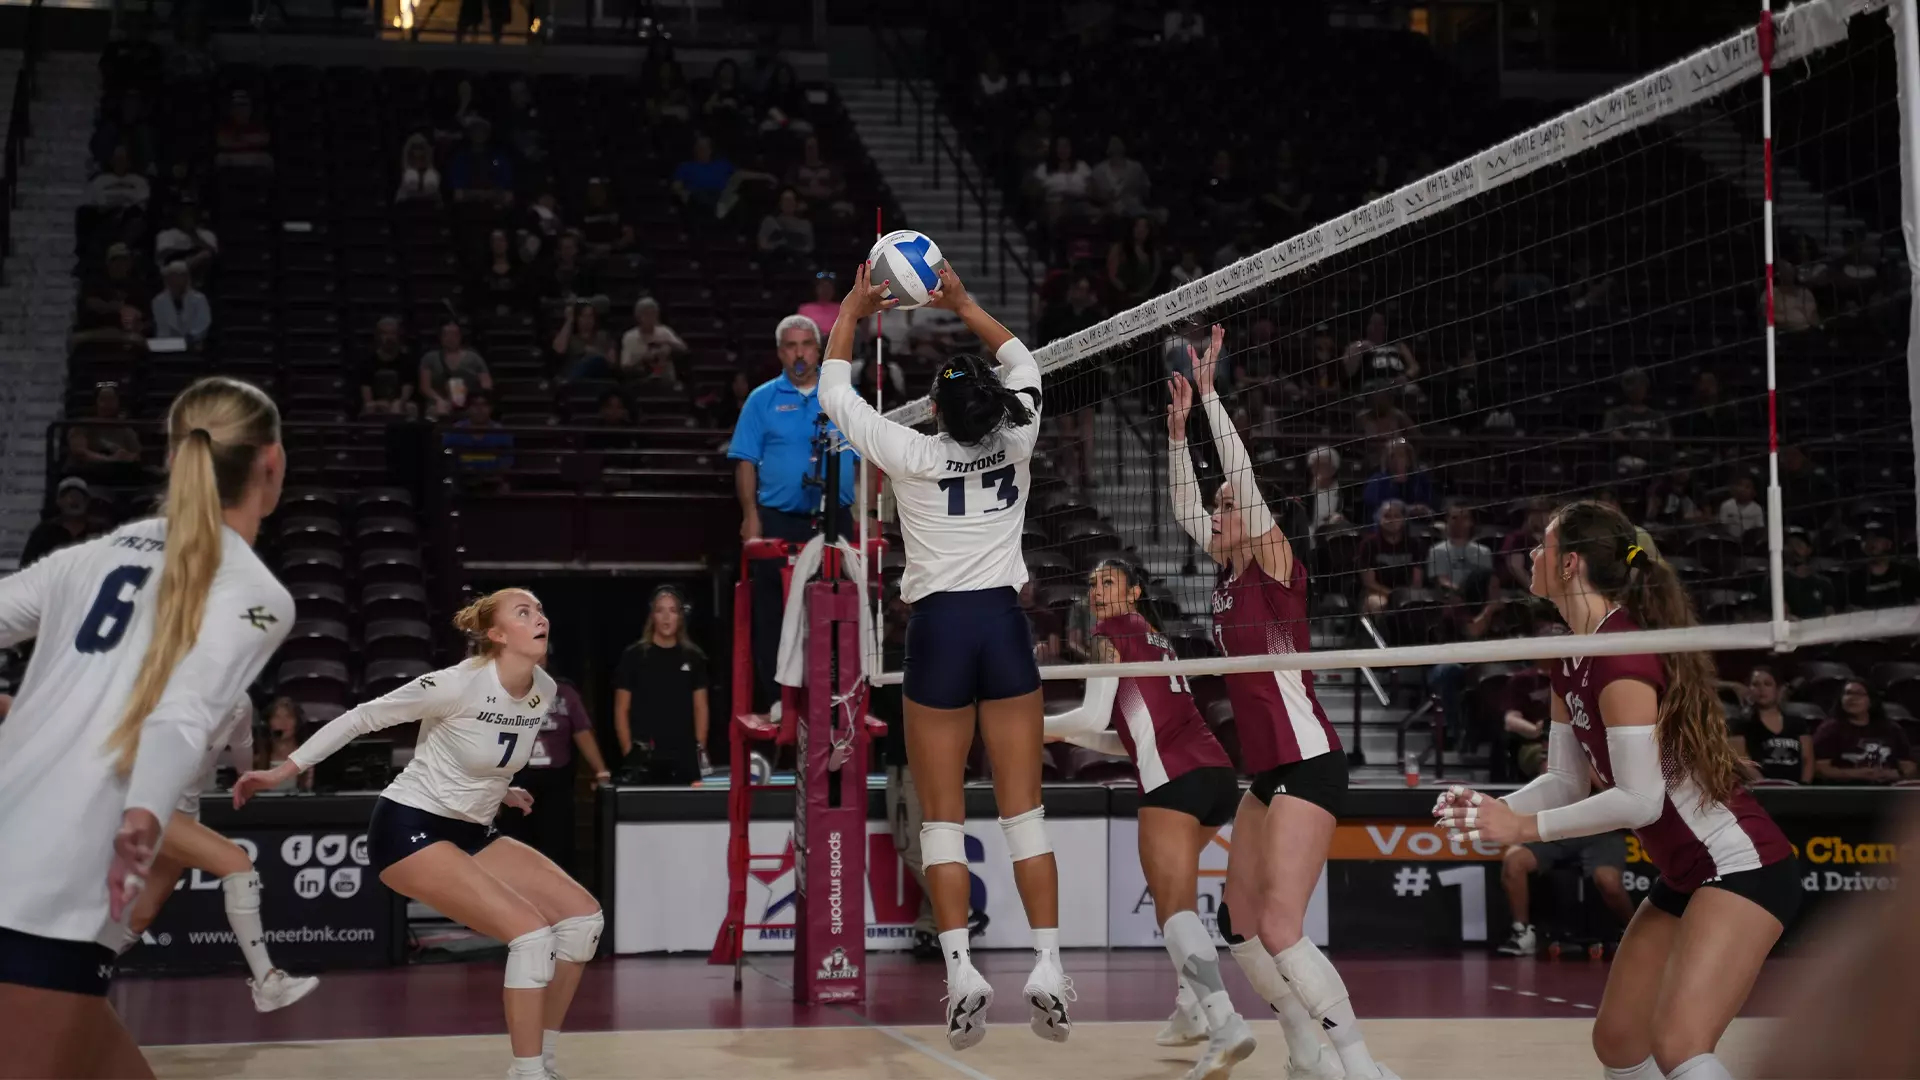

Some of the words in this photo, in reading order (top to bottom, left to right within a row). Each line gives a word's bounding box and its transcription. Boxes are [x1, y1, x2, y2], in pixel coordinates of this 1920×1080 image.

[1510, 134, 1536, 157] WHITE
[946, 450, 1006, 473] TRITONS
[937, 463, 1019, 516] 13
[75, 565, 153, 654] 6
[476, 711, 495, 724] UC
[494, 714, 515, 727] San
[515, 715, 541, 729] Diego
[496, 731, 518, 768] 7
[828, 832, 843, 876] sports
[1806, 835, 1898, 865] Chan
[1824, 870, 1900, 892] Driver
[828, 879, 844, 936] imports
[1392, 863, 1489, 942] #1
[188, 925, 375, 944] www.neerbnk.com
[833, 965, 860, 980] STATE
